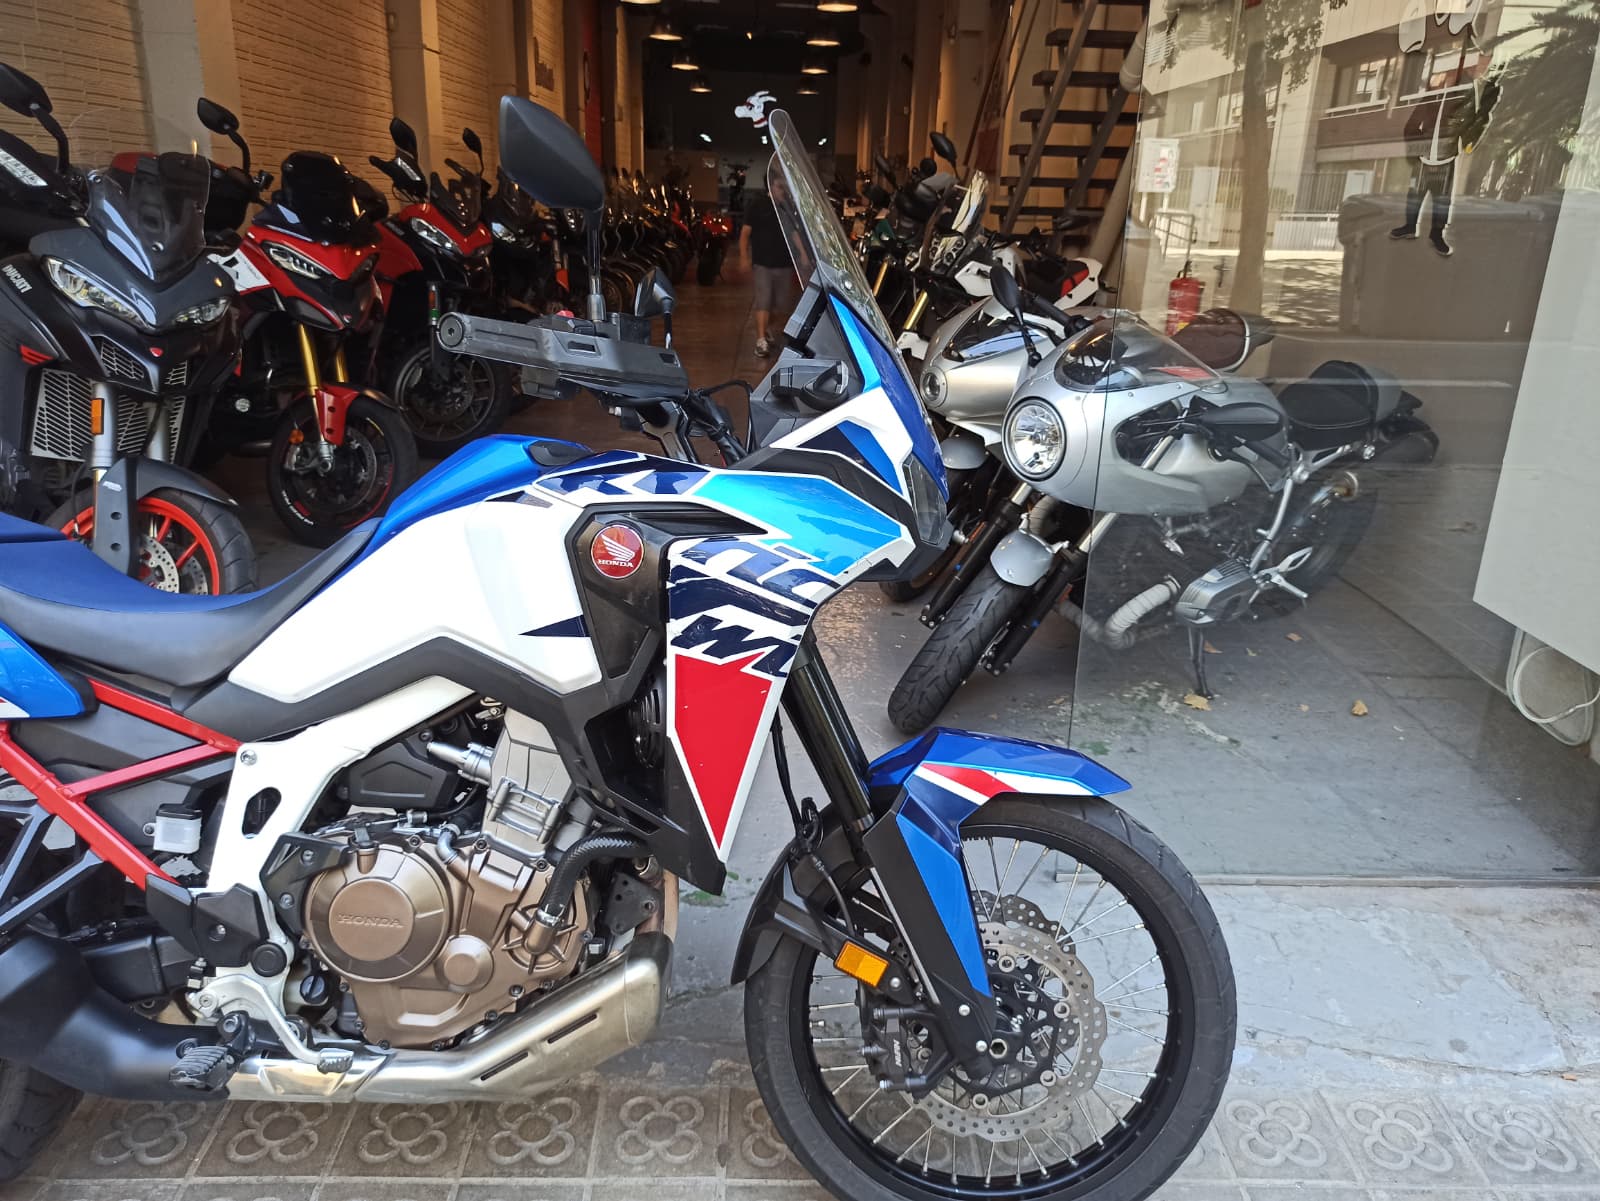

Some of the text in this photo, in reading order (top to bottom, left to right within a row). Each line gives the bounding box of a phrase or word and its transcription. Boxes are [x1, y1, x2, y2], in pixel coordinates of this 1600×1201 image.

[2, 264, 32, 293] DUCATI
[598, 559, 634, 567] HONDA
[336, 913, 404, 928] HONDA
